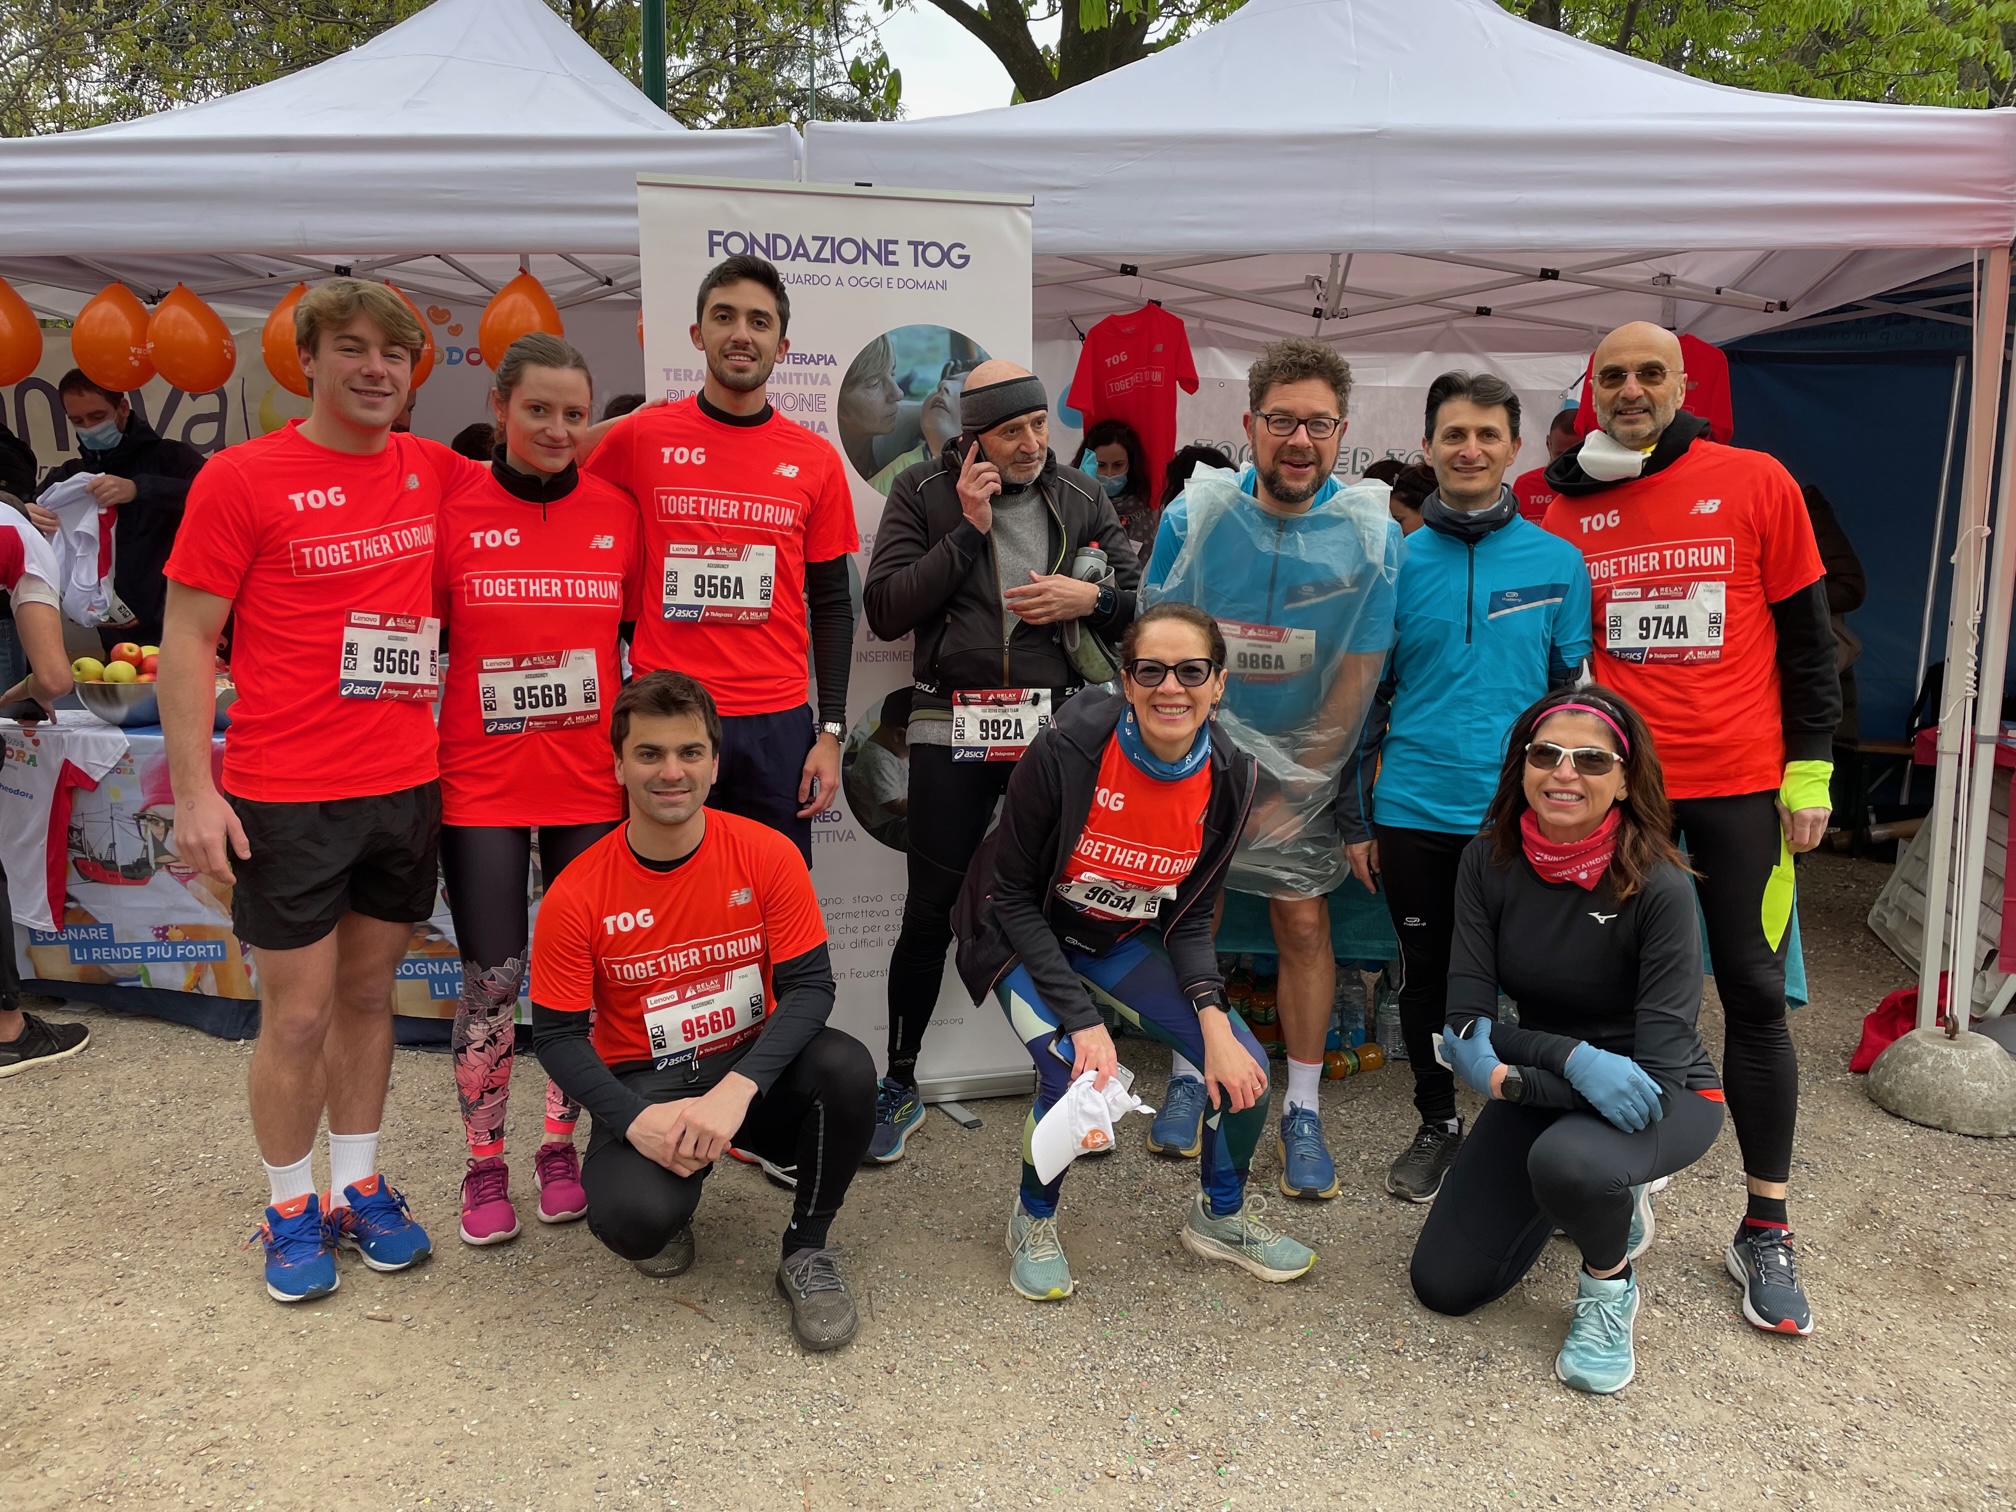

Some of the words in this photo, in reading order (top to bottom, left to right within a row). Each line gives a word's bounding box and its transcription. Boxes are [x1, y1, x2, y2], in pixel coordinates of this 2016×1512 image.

[708, 230, 899, 267] FONDAZIONE
[907, 240, 971, 269] TOG
[778, 273, 831, 286] GUARDO
[835, 276, 844, 287] A
[848, 277, 883, 289] OGGI
[887, 278, 893, 289] E
[897, 278, 947, 291] DOMANI
[1105, 351, 1128, 368] TOG
[661, 447, 706, 465] TOG
[288, 486, 346, 511] TOG
[1530, 495, 1552, 504] TOG
[660, 495, 739, 520] TOGETHER
[743, 501, 762, 522] TO
[763, 505, 795, 527] RUN
[1580, 509, 1620, 533] TOG
[470, 528, 521, 548] TOG
[301, 533, 394, 568] TOGETHER
[392, 529, 413, 552] TO
[1663, 549, 1685, 569] TO
[1688, 546, 1725, 567] RUN
[472, 578, 562, 598] TOGETHER
[564, 579, 586, 598] TO
[588, 580, 618, 600] RUN
[694, 574, 744, 599] 956A
[353, 614, 378, 623] Lenovo
[1638, 615, 1689, 640] 974A
[373, 647, 420, 675] 956C
[1237, 652, 1285, 670] 986A
[513, 683, 567, 710] 956B
[979, 718, 1024, 741] 992A
[5, 746, 38, 767] ORA
[0, 783, 34, 800] heodora
[1074, 834, 1148, 870] OGETHER
[1149, 855, 1171, 874] TO
[852, 894, 883, 904] stavo
[603, 908, 655, 935] TOG
[827, 909, 890, 922] permetteva
[35, 928, 109, 942] SOGNARE
[839, 924, 859, 935] che
[863, 925, 881, 935] per
[74, 949, 87, 960] LI
[92, 946, 142, 960] RENDE
[147, 942, 172, 958] PIÙ
[176, 945, 221, 958] FORTI
[829, 943, 846, 953] più
[850, 937, 883, 949] difficili
[611, 948, 701, 981] TOGETHER
[702, 943, 725, 963] TO
[727, 933, 761, 959] RUN
[850, 968, 888, 979] Feuerst
[434, 983, 445, 995] LI
[696, 979, 719, 989] RELAY
[649, 994, 675, 1005] Lenovo
[681, 1006, 736, 1042] 956D
